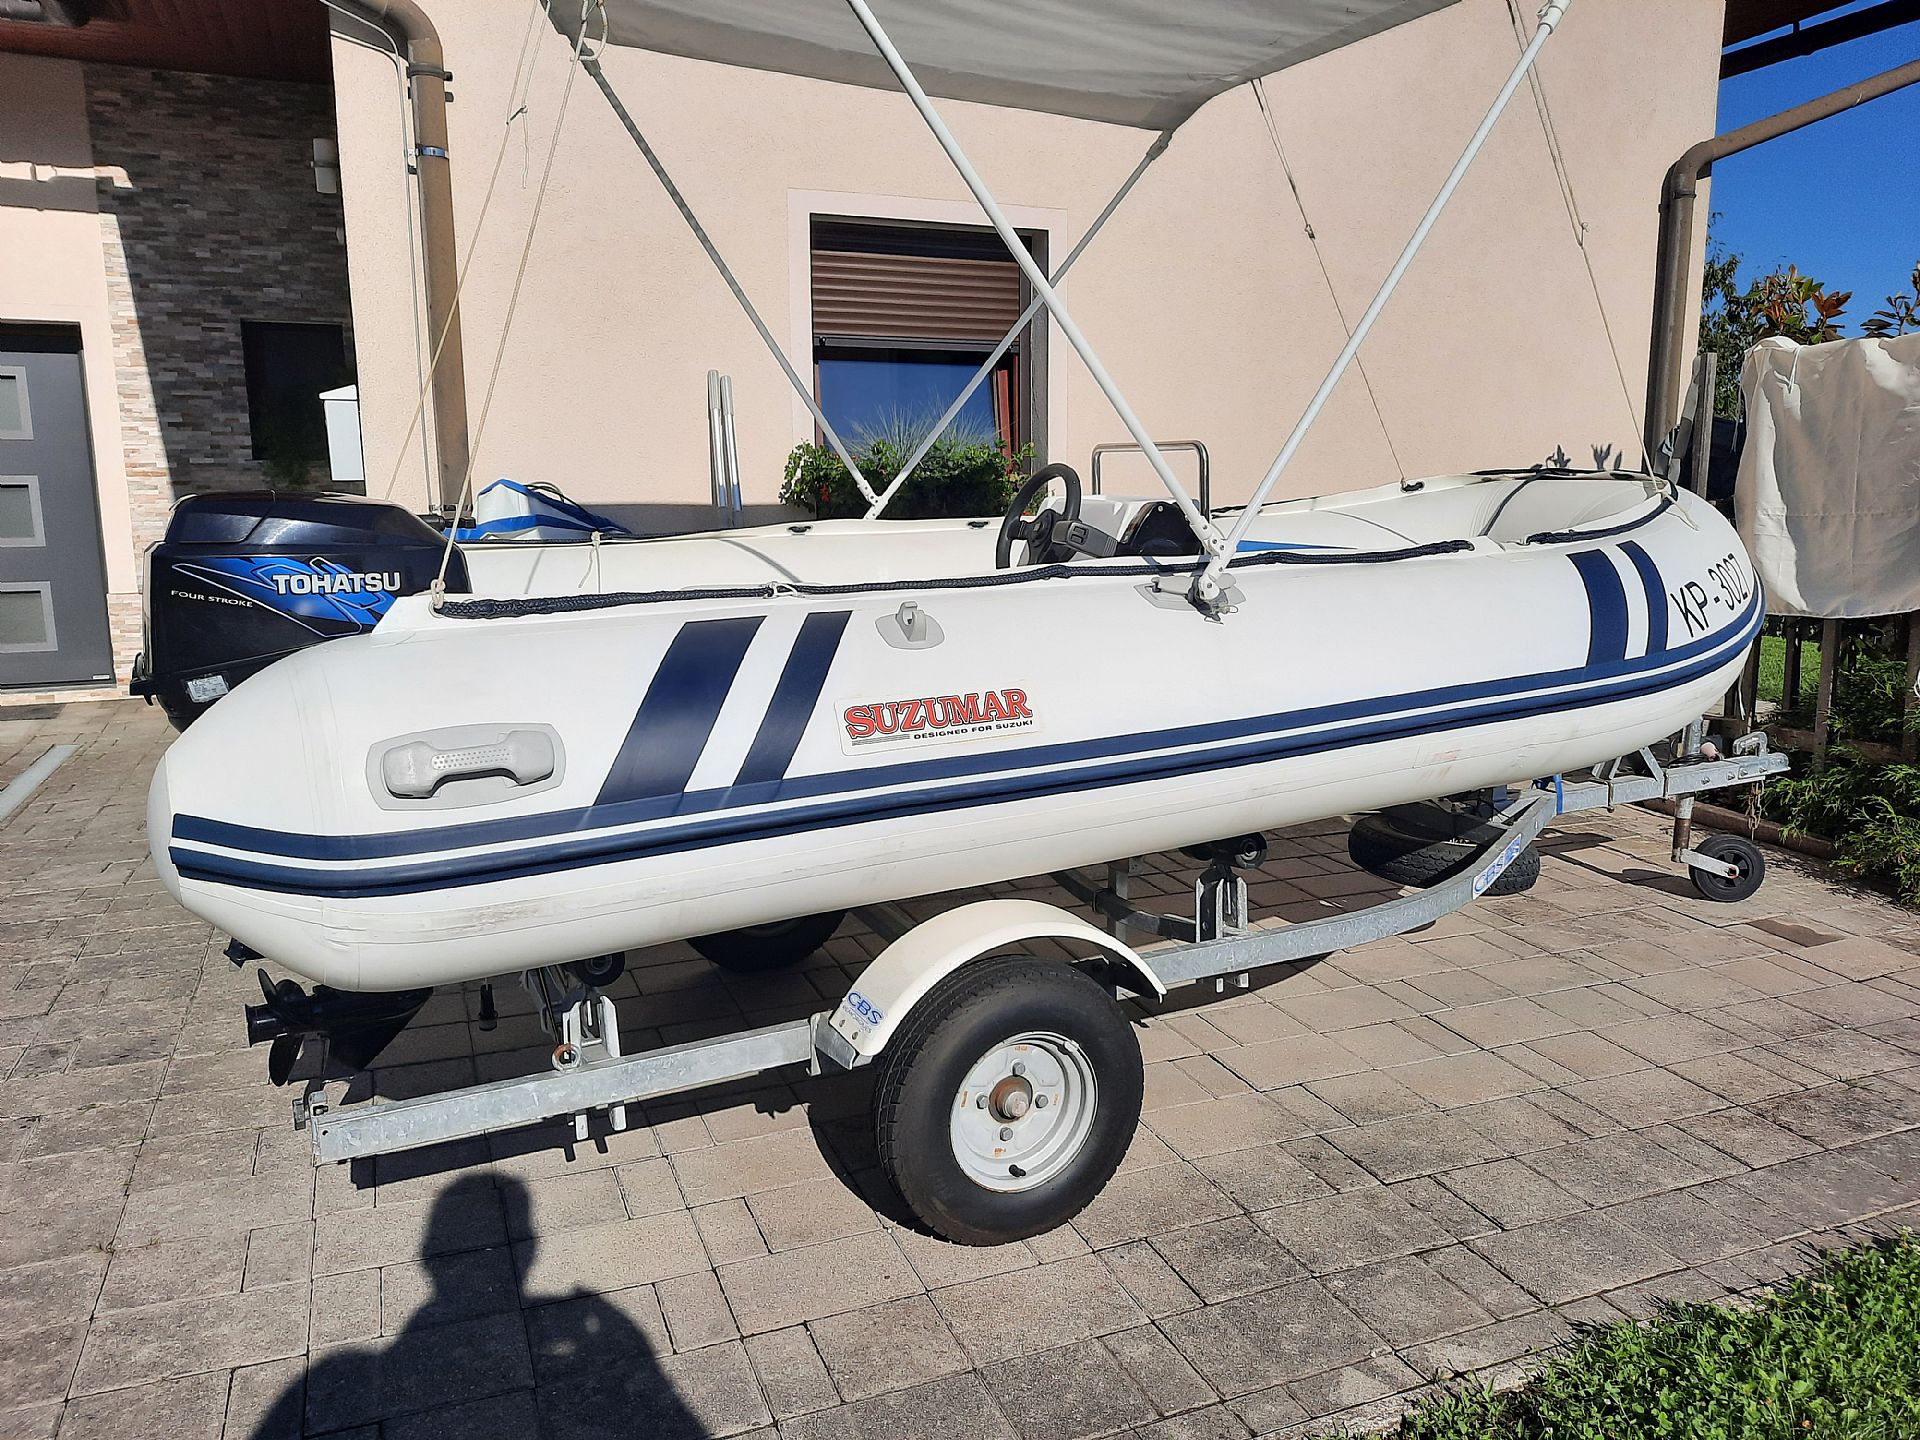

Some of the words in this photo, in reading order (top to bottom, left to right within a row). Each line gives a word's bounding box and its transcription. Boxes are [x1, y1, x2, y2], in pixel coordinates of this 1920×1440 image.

[272, 572, 401, 595] TOHATSU
[1669, 553, 1751, 638] KP-3027
[170, 589, 205, 601] FOUR
[208, 595, 253, 608] STROKE
[844, 688, 1033, 740] SUZUMAR
[913, 728, 969, 740] DESIGNED
[971, 725, 992, 733] FOR
[995, 720, 1033, 730] SUZUKI
[847, 992, 883, 1024] CBS
